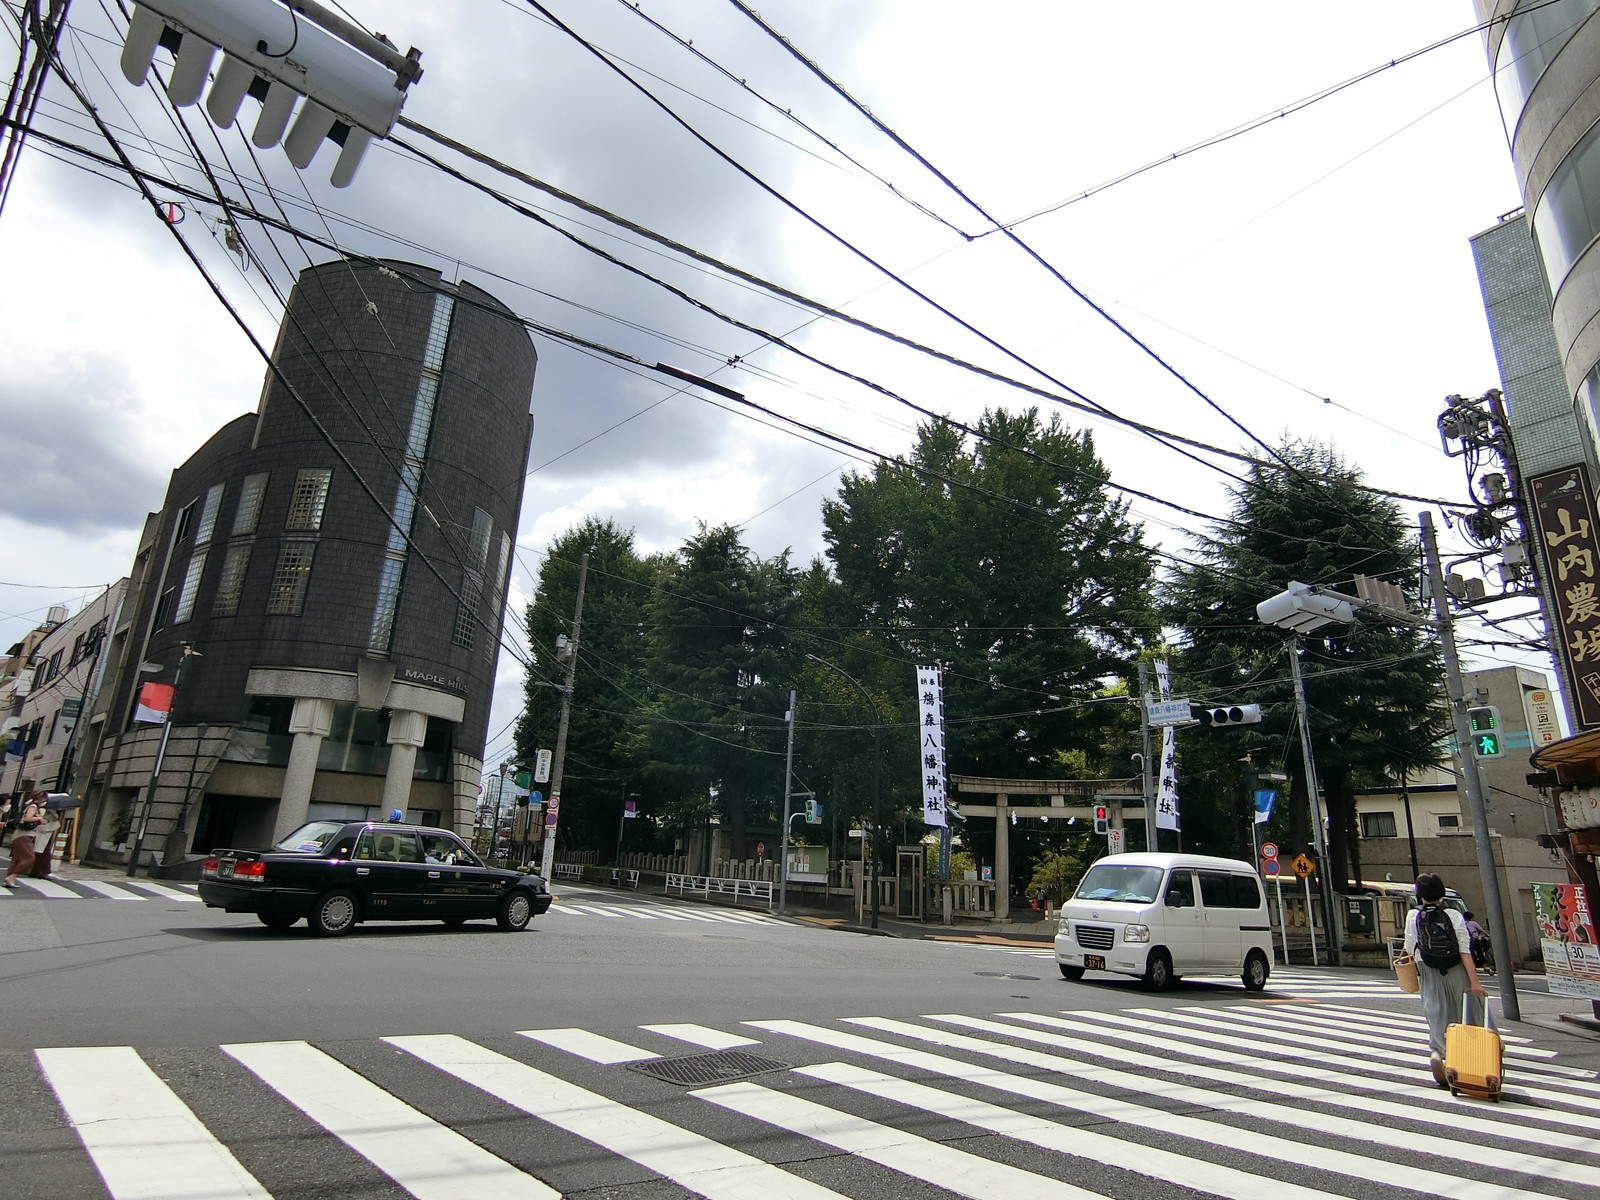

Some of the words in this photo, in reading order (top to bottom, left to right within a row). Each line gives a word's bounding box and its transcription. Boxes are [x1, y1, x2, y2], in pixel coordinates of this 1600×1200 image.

[405, 669, 446, 685] MAPLE
[447, 679, 470, 693] HILLS
[922, 691, 941, 812] 鳩森八幡神社
[1264, 846, 1275, 855] 30
[1571, 946, 1585, 959] 30
[1088, 959, 1105, 969] 37-16
